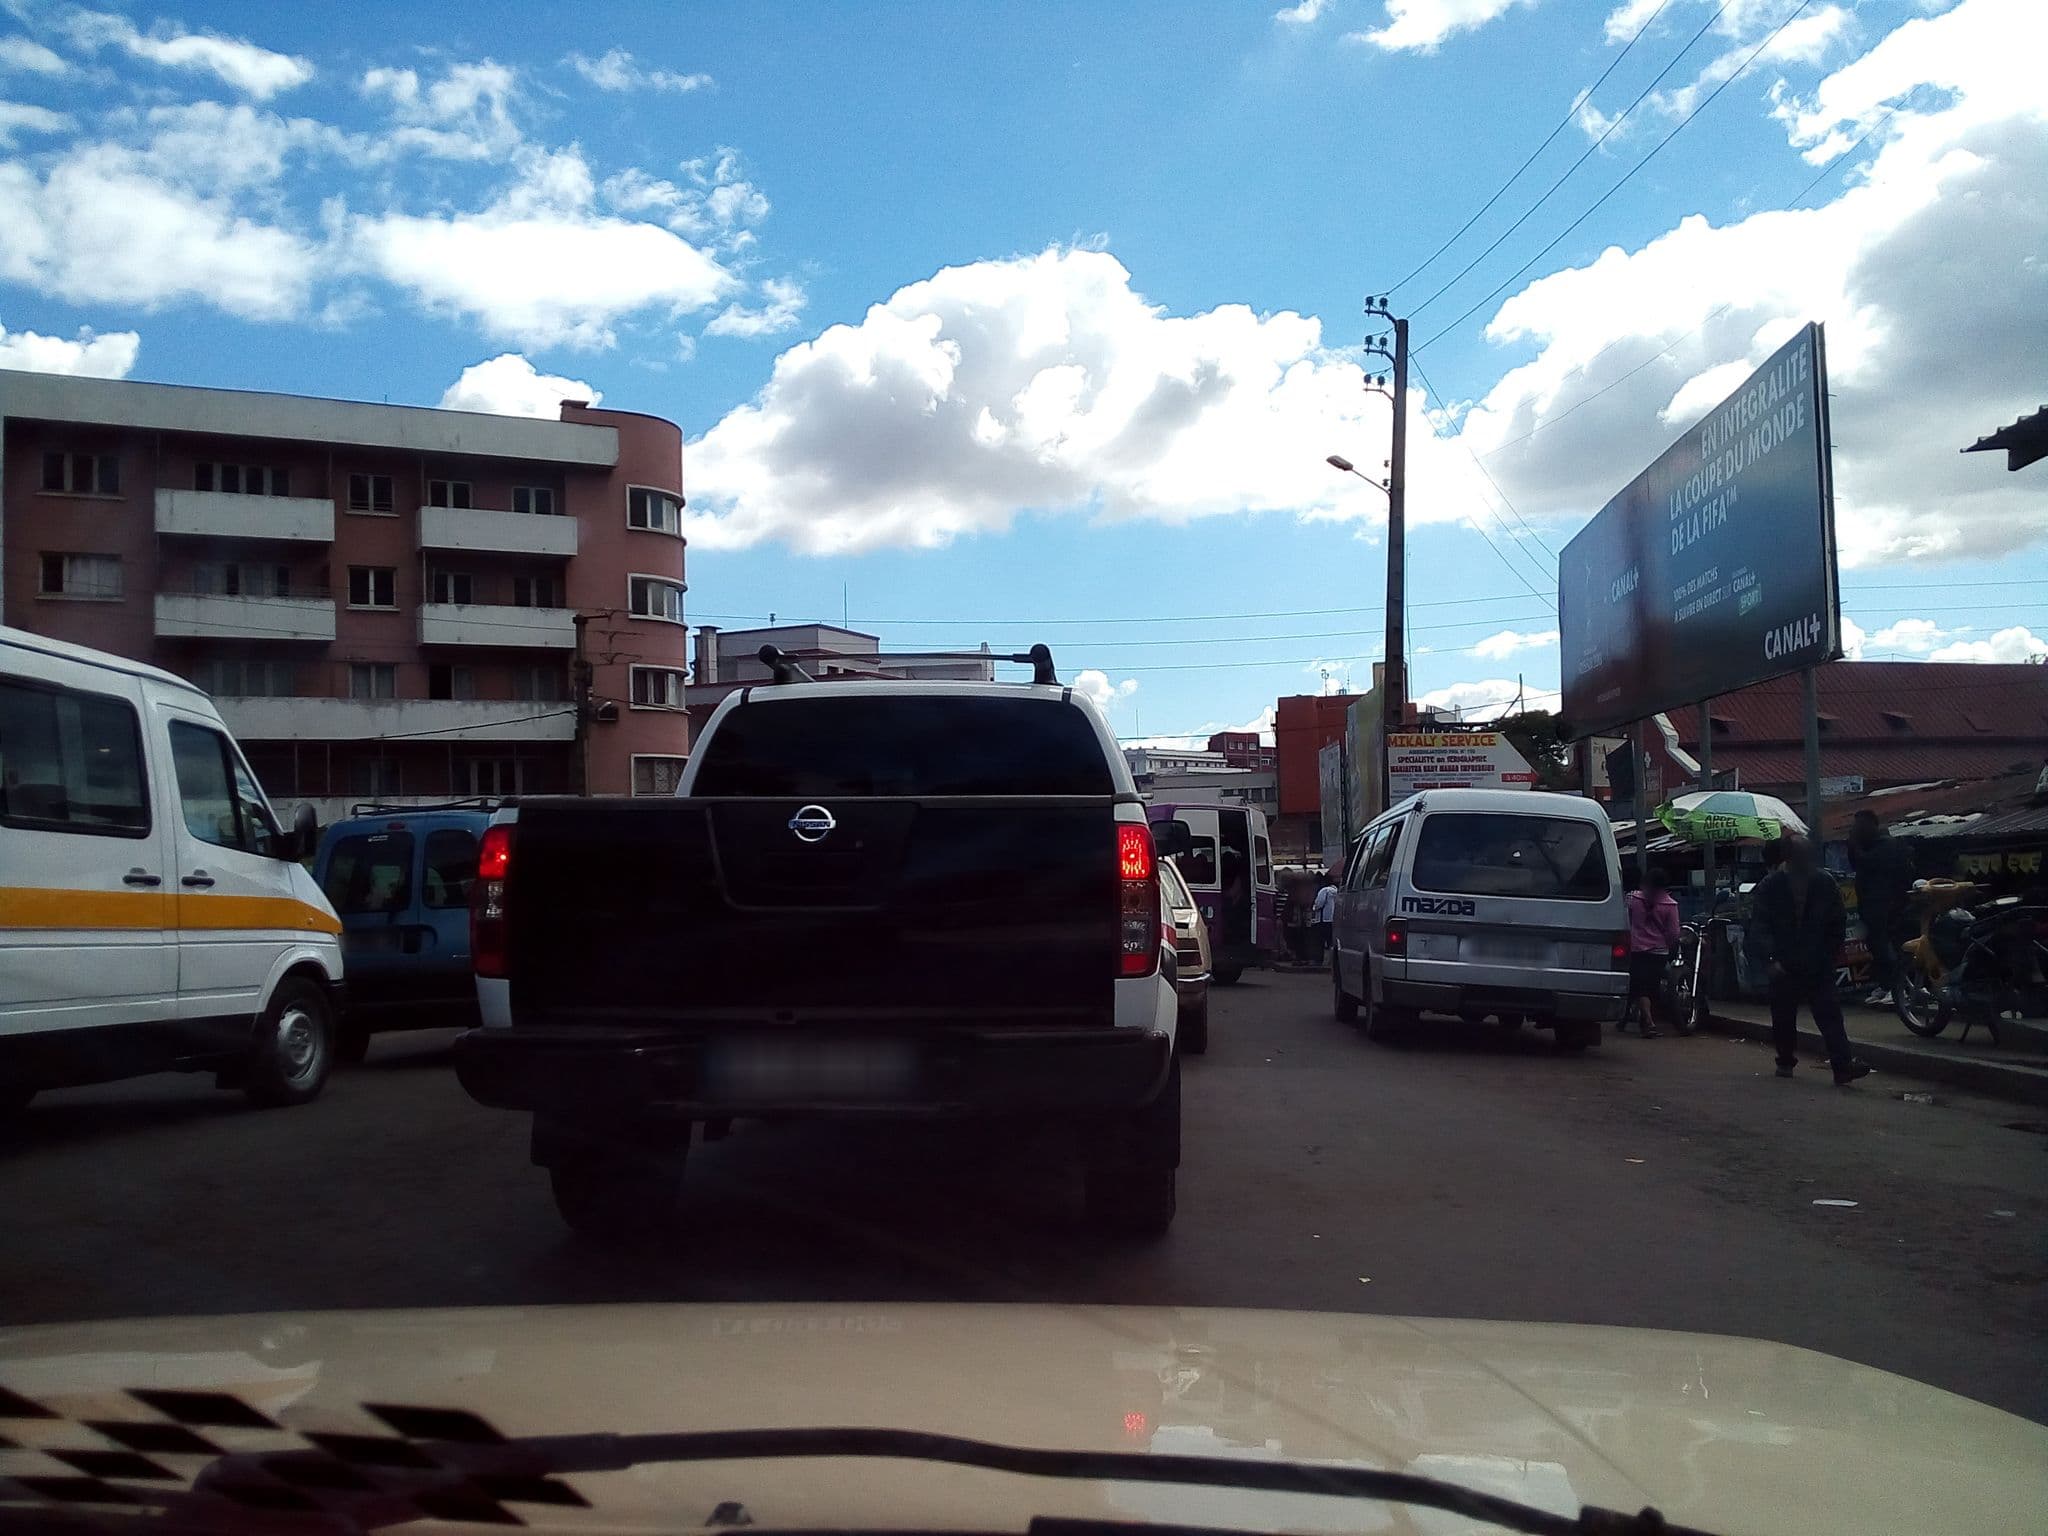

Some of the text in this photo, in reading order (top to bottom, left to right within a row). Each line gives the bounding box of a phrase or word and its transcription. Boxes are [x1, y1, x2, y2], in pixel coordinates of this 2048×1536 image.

[1670, 392, 1805, 521] LA COUPE DU MONDE
[1701, 424, 1717, 460] EN
[1671, 525, 1685, 556] DE
[1687, 511, 1700, 541] LA
[1611, 566, 1639, 603] CANAL+
[1696, 566, 1718, 589] MATCHS
[1704, 588, 1722, 609] DIRECT
[1764, 613, 1821, 660] CANAL+
[1388, 735, 1497, 747] MIKALY SERVICE
